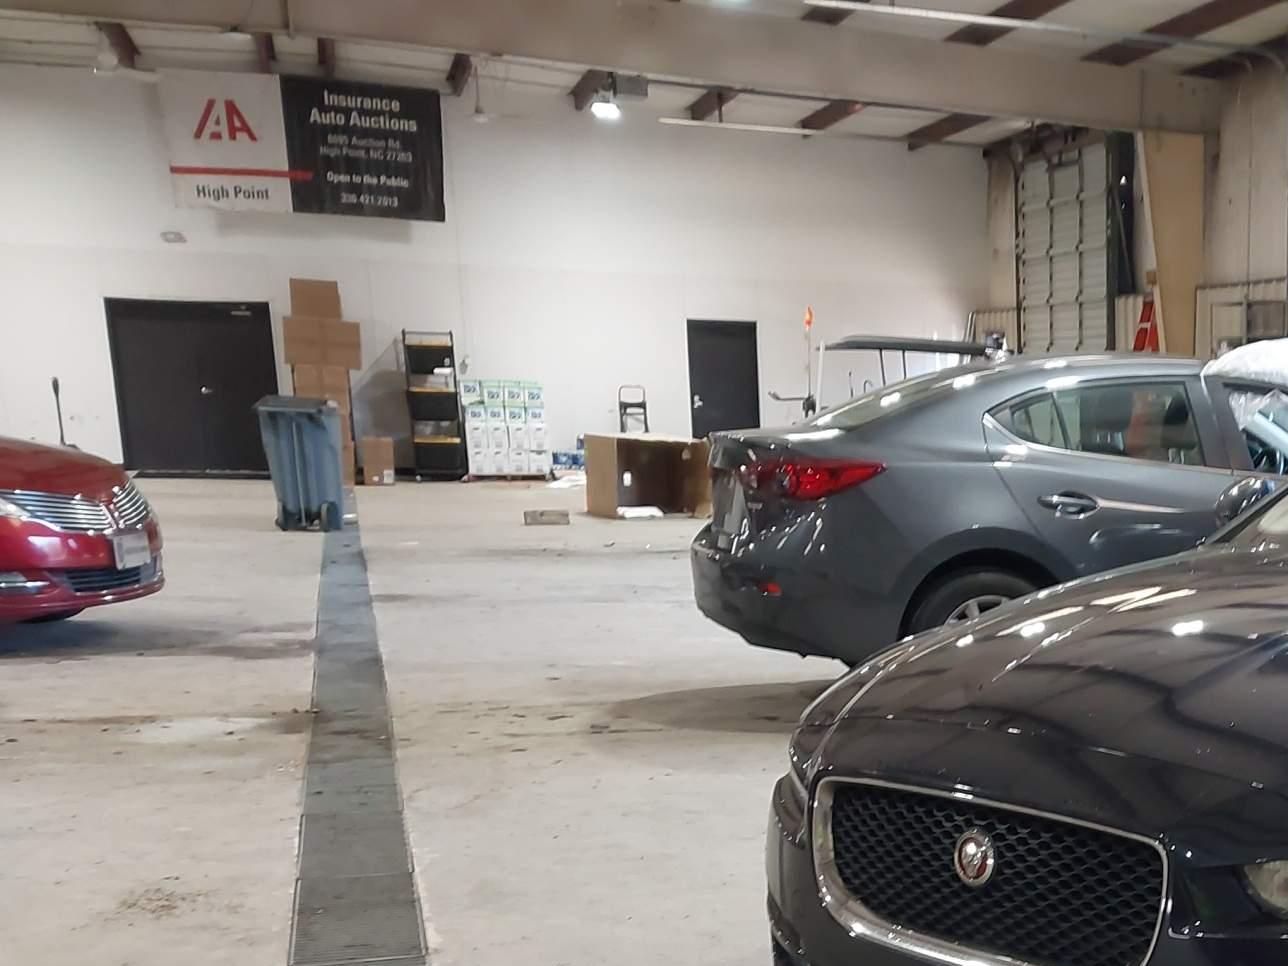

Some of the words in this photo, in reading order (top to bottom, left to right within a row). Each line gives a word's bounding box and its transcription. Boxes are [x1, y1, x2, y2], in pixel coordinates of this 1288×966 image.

[323, 88, 400, 112] Insurance
[309, 107, 345, 125] Auto
[349, 110, 417, 132] Auctions
[320, 145, 341, 158] High
[326, 171, 350, 184] Open
[352, 173, 362, 184] to
[363, 174, 378, 185] the
[380, 174, 409, 188] Public
[195, 184, 230, 201] High
[234, 185, 270, 201] Point
